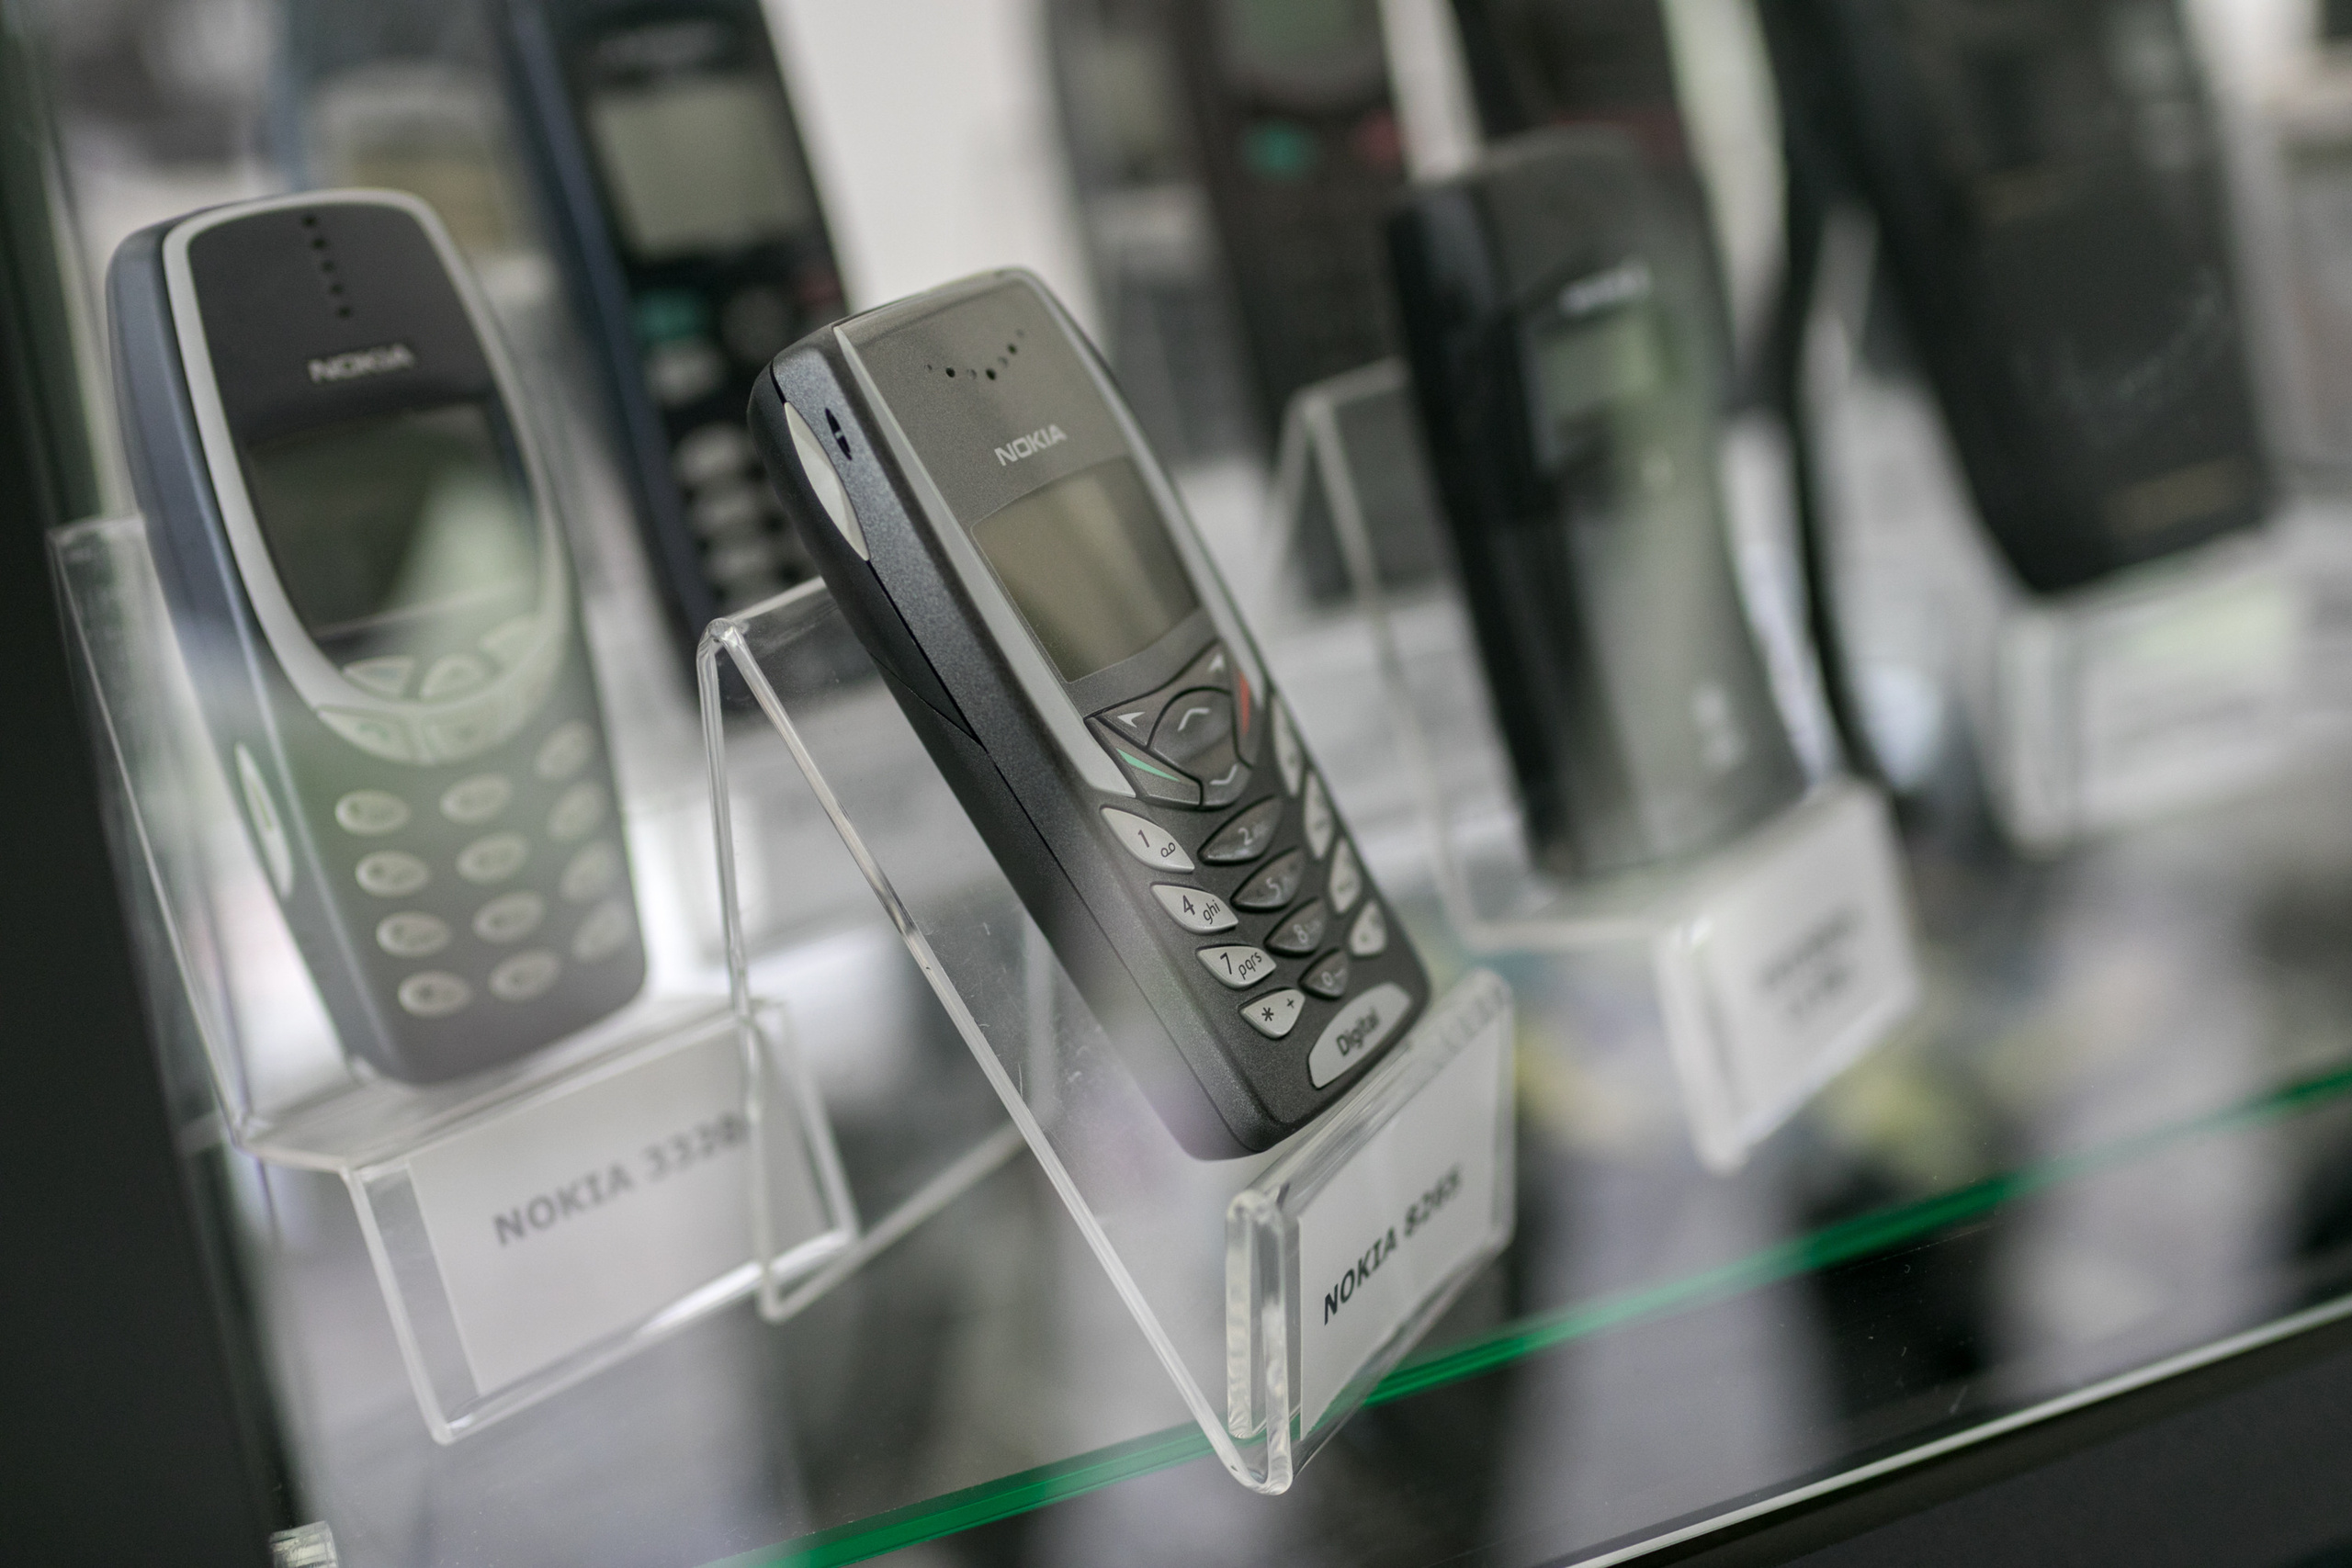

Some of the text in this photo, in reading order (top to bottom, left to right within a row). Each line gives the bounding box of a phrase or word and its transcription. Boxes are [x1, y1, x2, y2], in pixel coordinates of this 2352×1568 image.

[307, 342, 414, 384] NOKIA
[994, 424, 1067, 466] NOKIA
[1137, 829, 1149, 848] 1
[1238, 827, 1252, 846] 2
[1182, 894, 1221, 924] 4 ghi
[1219, 952, 1263, 980] 7 pqrs
[1335, 1007, 1381, 1057] Digital
[491, 1160, 636, 1248] NOKIA
[1323, 1224, 1397, 1326] NOKIA
